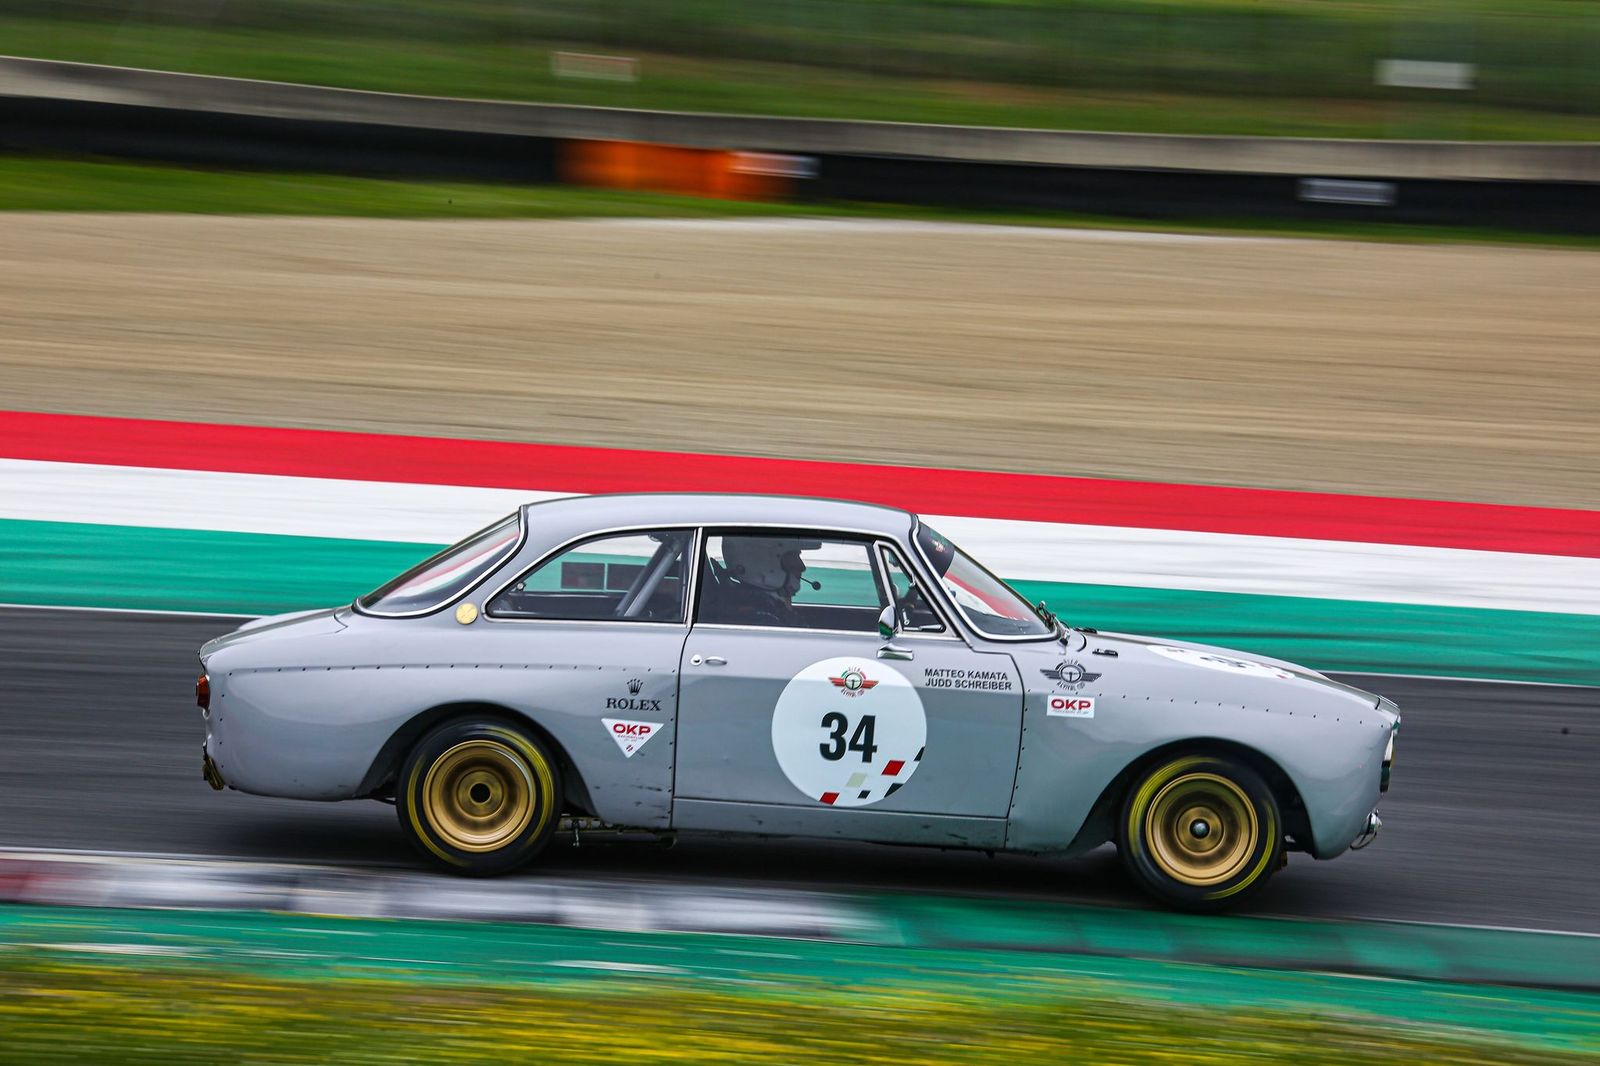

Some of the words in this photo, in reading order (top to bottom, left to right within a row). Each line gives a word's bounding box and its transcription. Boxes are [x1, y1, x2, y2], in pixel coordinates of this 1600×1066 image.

[924, 668, 965, 679] MATTEO
[967, 670, 1008, 681] KAMATA
[925, 678, 952, 688] JUDD
[954, 679, 1012, 691] SCHREIBER
[606, 697, 661, 712] ROLEX
[1050, 698, 1091, 711] OKP
[613, 723, 651, 736] OKP
[819, 711, 878, 763] 34
